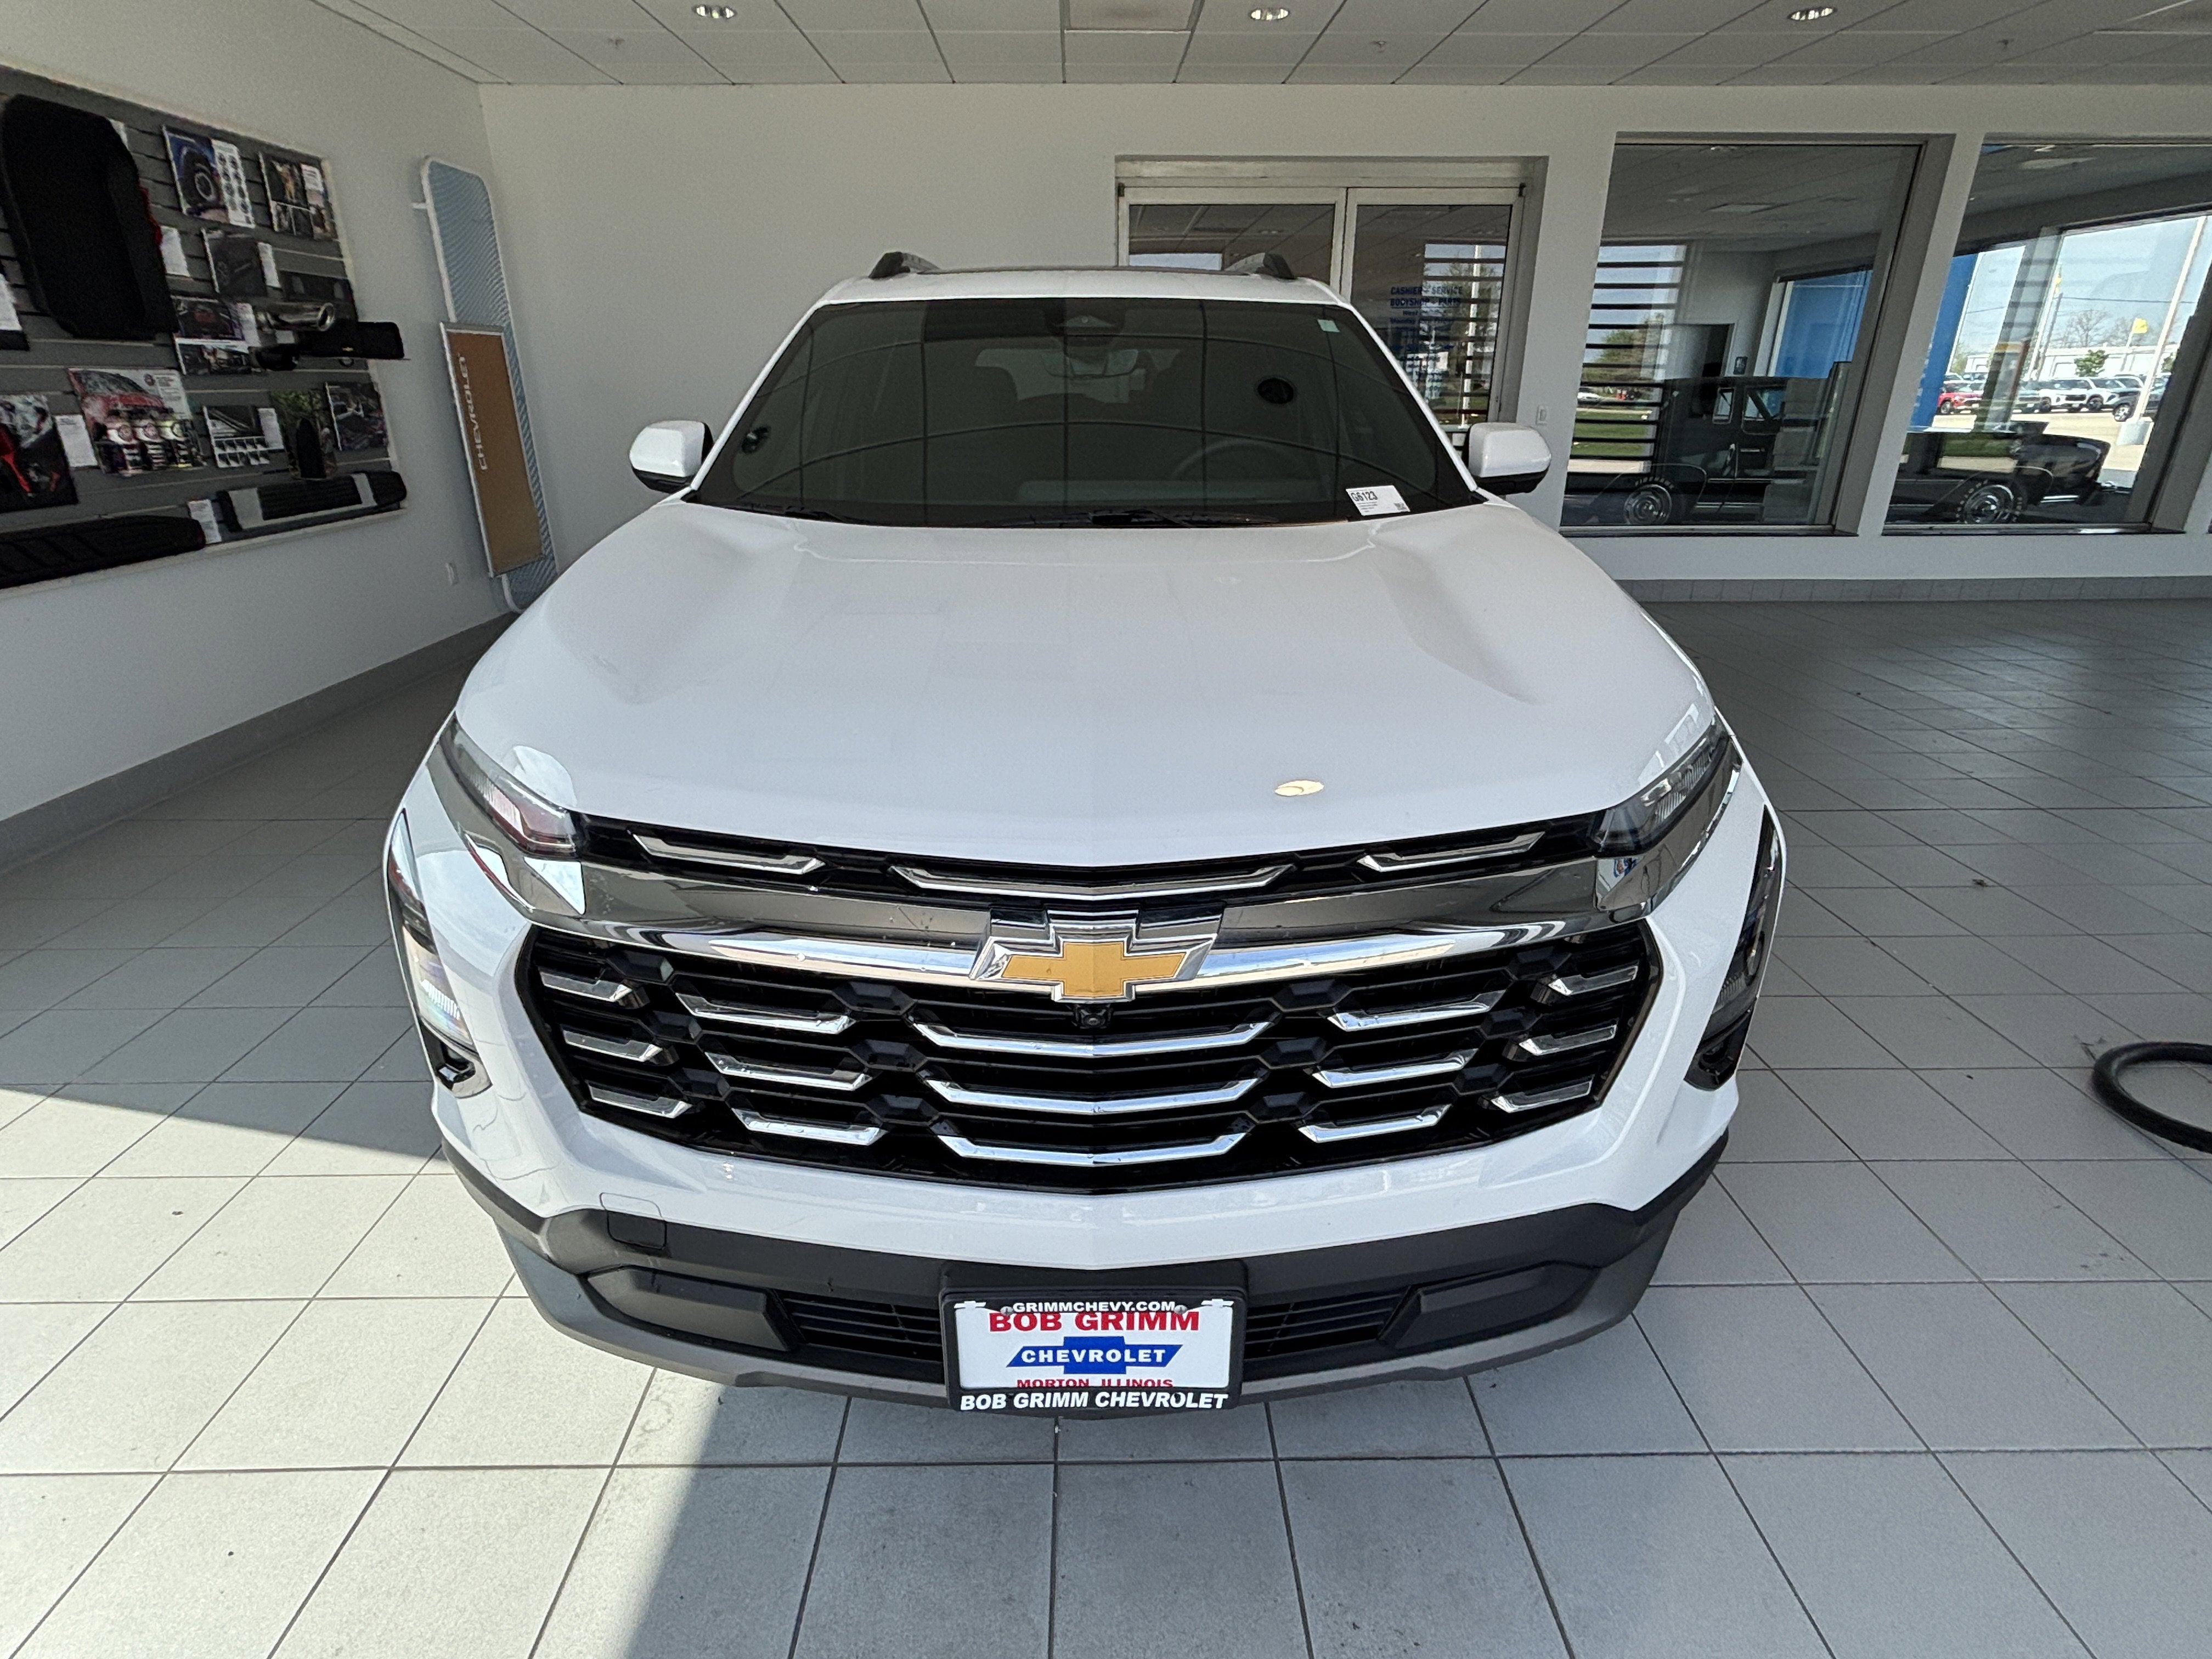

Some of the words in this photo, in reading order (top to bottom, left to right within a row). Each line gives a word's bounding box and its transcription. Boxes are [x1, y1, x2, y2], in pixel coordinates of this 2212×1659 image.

[1390, 286, 1423, 295] CASHIER
[1431, 286, 1463, 295] SERVICE
[458, 353, 487, 470] CHEVROLET
[1351, 491, 1378, 501] G6123
[1013, 1301, 1176, 1313] GRIMMCHEVY.COM
[989, 1312, 1062, 1332] BOB
[1074, 1311, 1200, 1331] GRIMM
[1021, 1349, 1166, 1363] CHEVROLET
[1017, 1378, 1090, 1388] MORTON
[960, 1393, 1007, 1411] BOB
[1013, 1391, 1089, 1409] GRIMM
[1095, 1391, 1229, 1409] CHEVROLET
